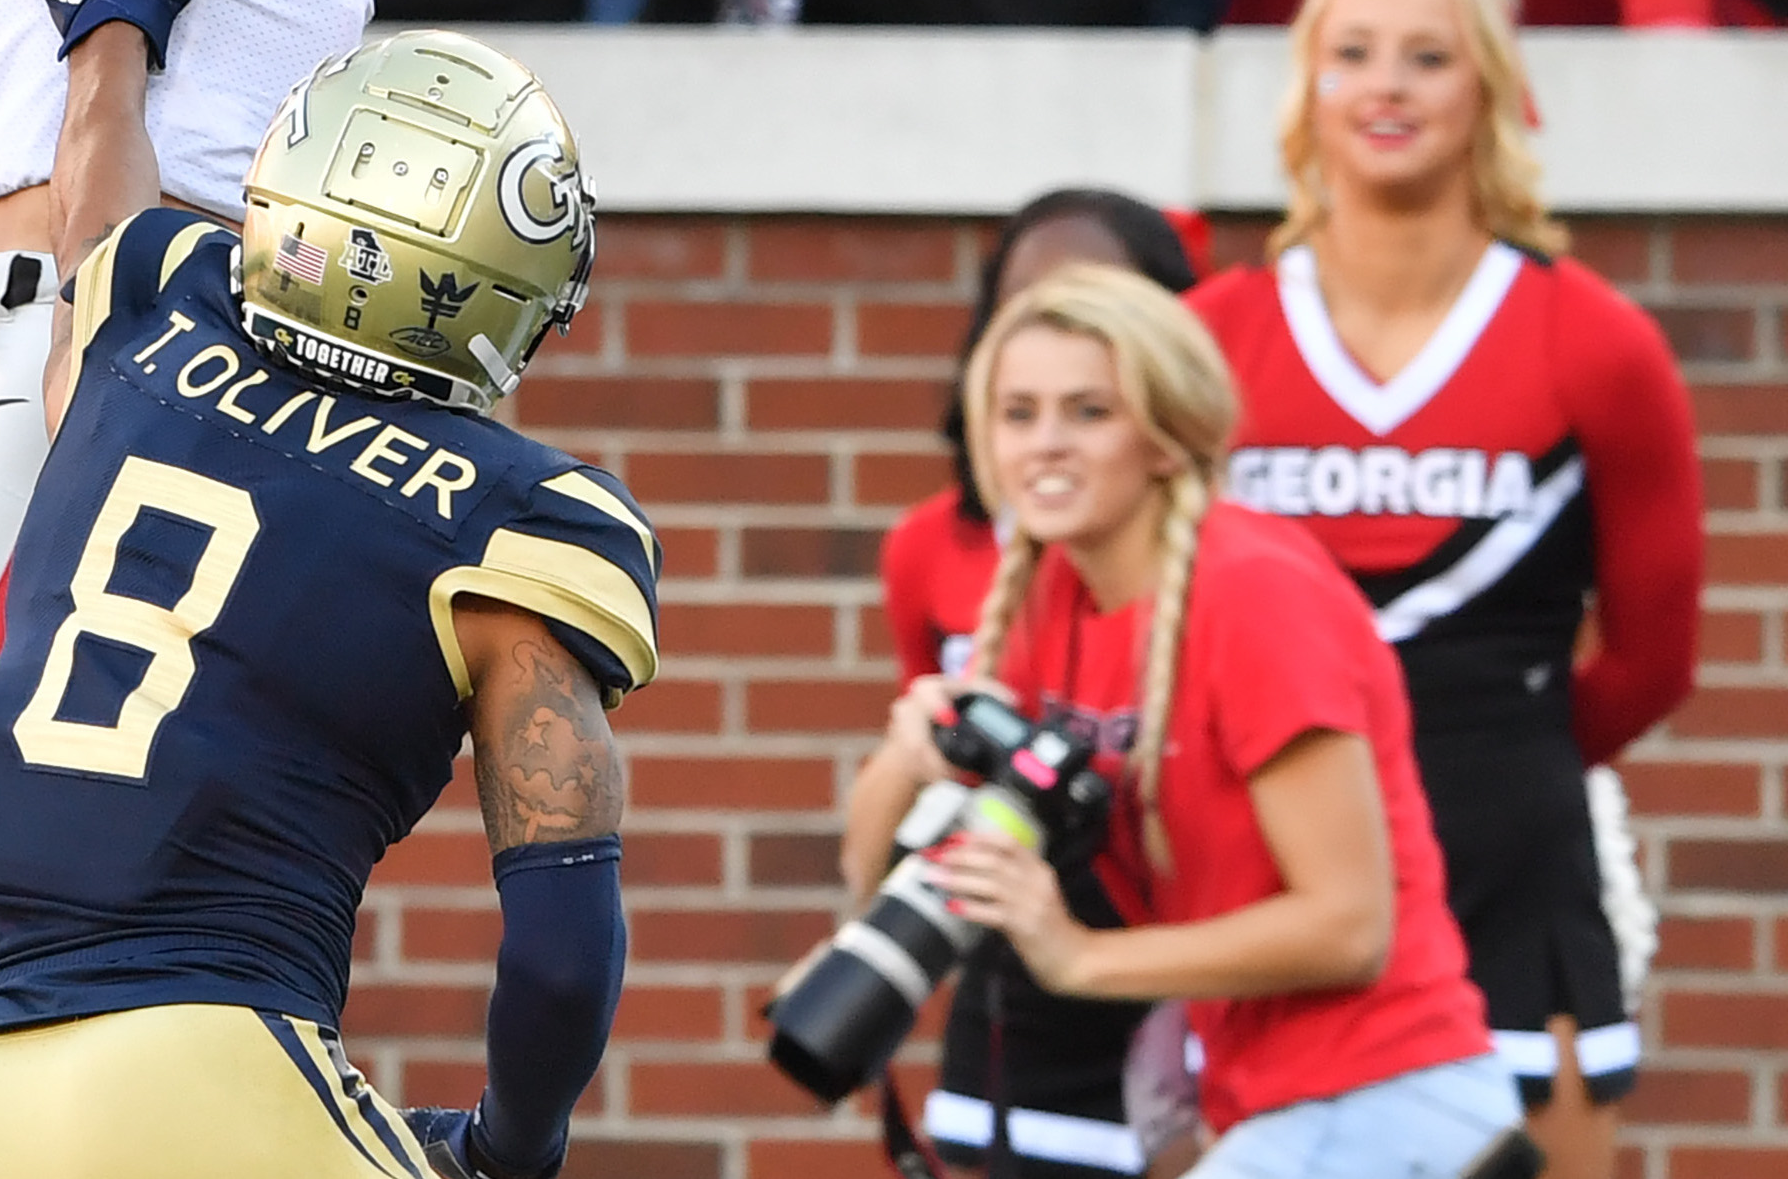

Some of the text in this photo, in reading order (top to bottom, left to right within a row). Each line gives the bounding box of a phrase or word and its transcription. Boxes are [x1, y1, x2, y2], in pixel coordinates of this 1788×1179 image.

[338, 241, 393, 282] ATL
[343, 305, 362, 331] 8
[295, 333, 390, 384] TOGETHER
[132, 310, 477, 520] T. OLIVER
[1226, 444, 1538, 518] GEORGIA
[12, 455, 260, 779] 8
